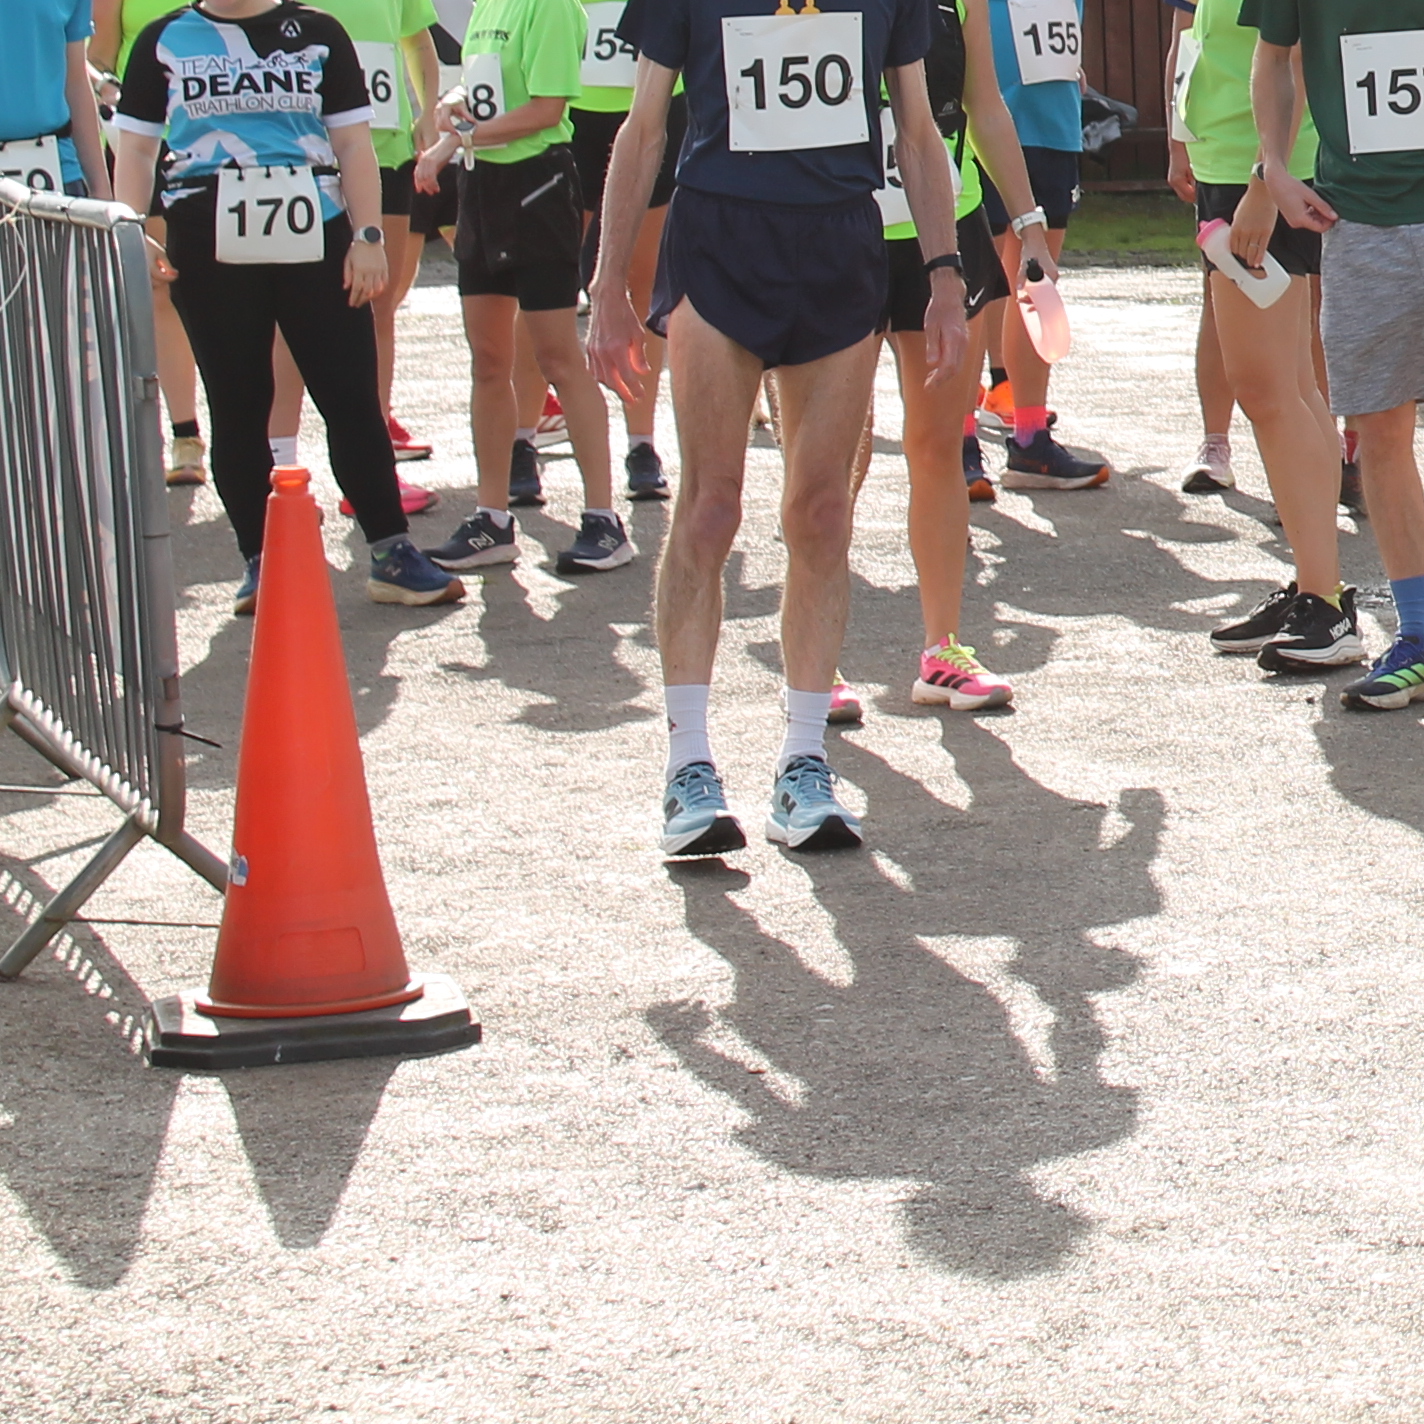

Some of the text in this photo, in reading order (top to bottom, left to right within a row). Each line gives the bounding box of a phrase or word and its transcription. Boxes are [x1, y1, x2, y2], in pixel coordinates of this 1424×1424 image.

[1023, 21, 1078, 56] 155
[181, 57, 243, 75] TEAM
[740, 54, 853, 110] 150
[182, 72, 313, 102] DEANE
[186, 95, 313, 117] TRIATHLON CLUB
[228, 195, 315, 237] 170
